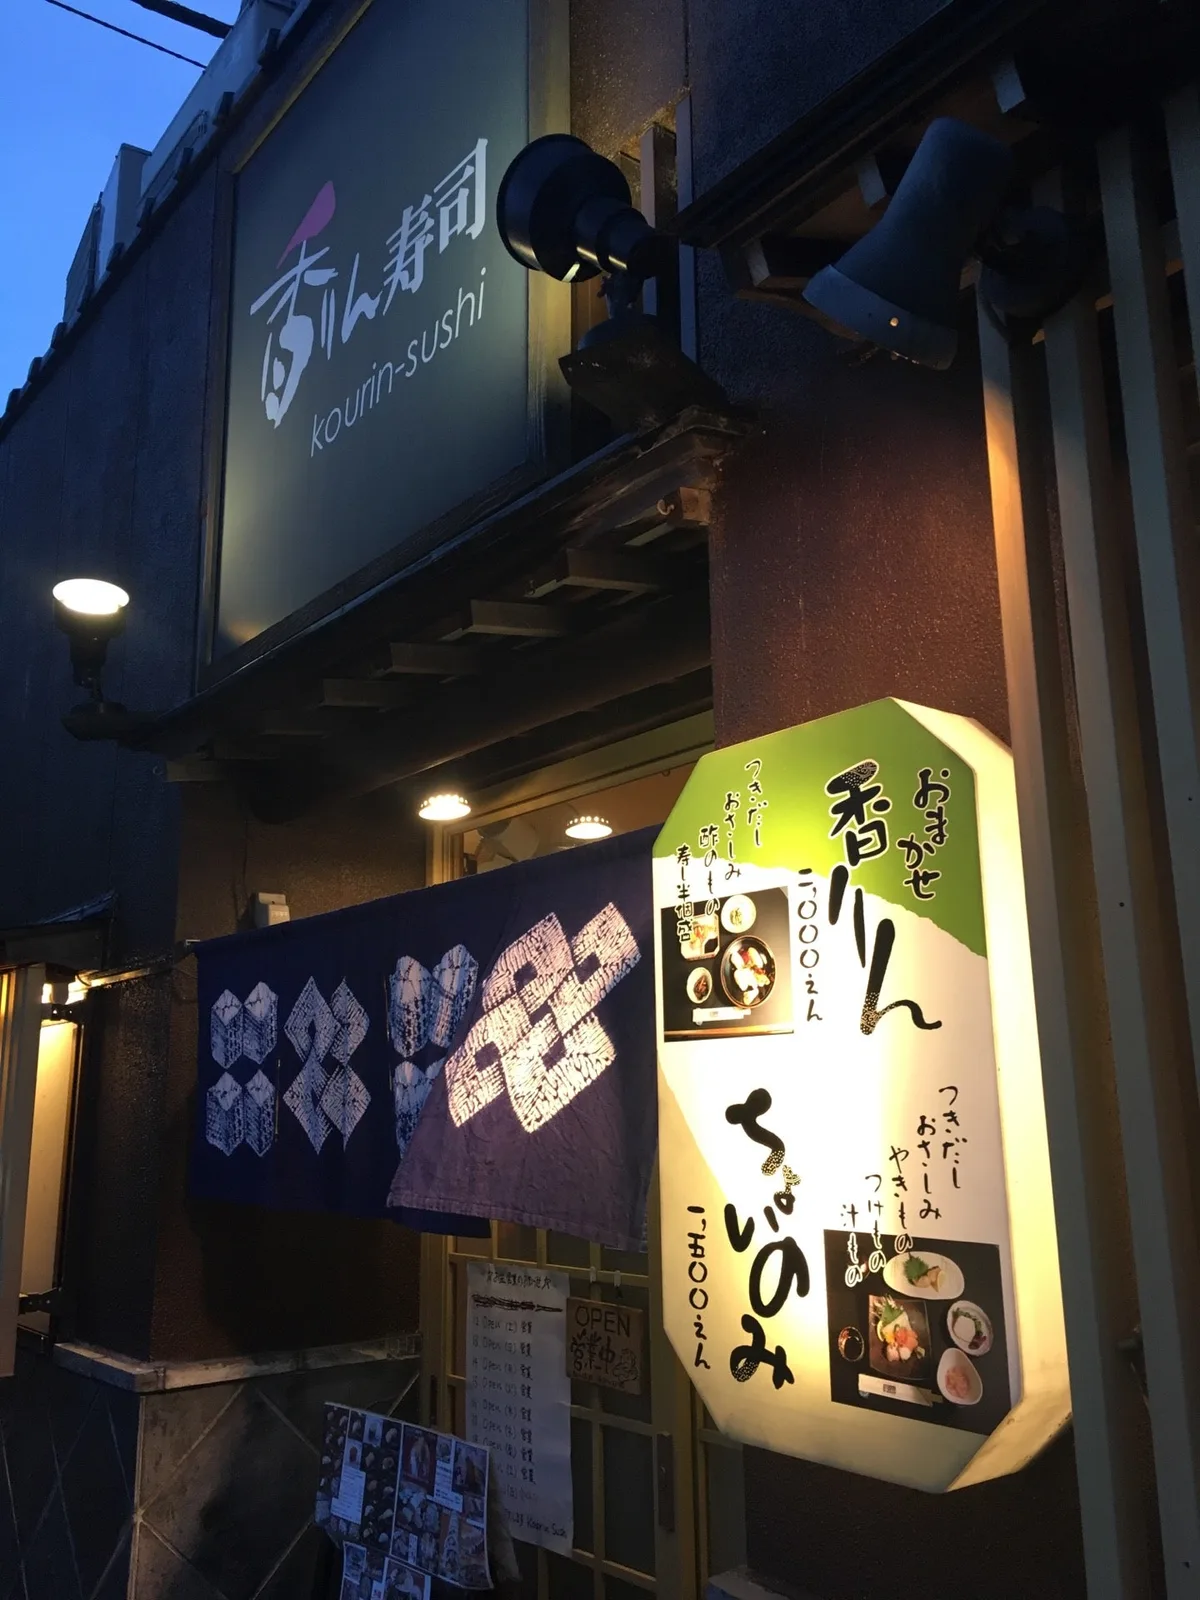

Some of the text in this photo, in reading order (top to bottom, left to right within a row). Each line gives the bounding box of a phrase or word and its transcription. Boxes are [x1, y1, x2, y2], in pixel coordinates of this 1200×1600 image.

[311, 267, 487, 457] kourin-sushi
[723, 792, 742, 880] おさしみ
[744, 759, 768, 847] つきだし
[897, 768, 950, 899] おまかせ
[698, 824, 720, 916] 酢のもの
[826, 759, 942, 1035] 香りん
[917, 1115, 942, 1220] おさしみ
[938, 1085, 968, 1189] つきだし
[840, 1203, 863, 1287] 汁もの
[864, 1174, 887, 1273] つけもの
[888, 1145, 913, 1254] やきもの
[575, 1305, 631, 1338] OPEN
